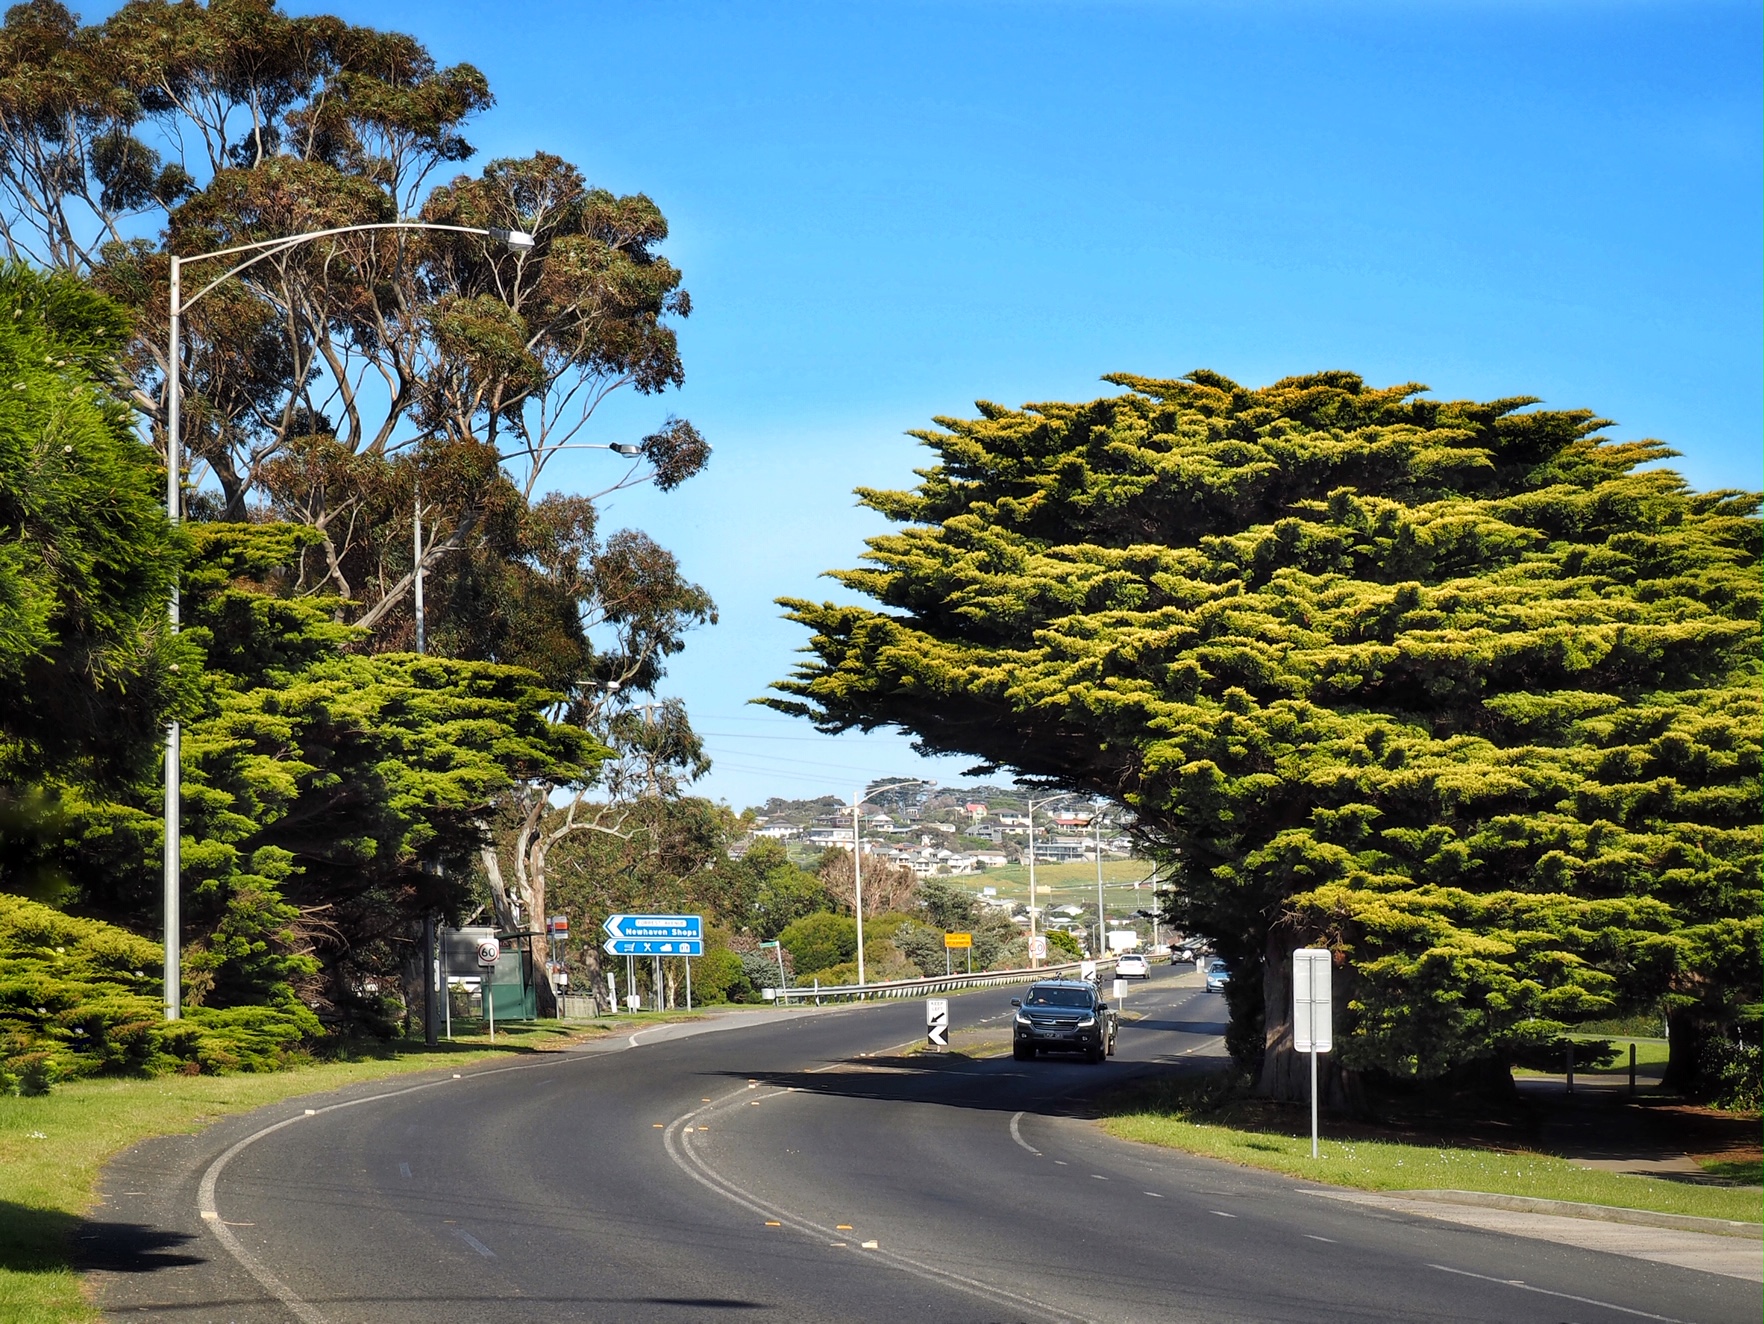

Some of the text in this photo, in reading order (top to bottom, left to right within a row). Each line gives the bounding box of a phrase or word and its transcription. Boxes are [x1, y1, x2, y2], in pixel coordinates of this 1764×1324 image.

[625, 928, 697, 937] Newhaven Shops
[481, 947, 496, 958] 60
